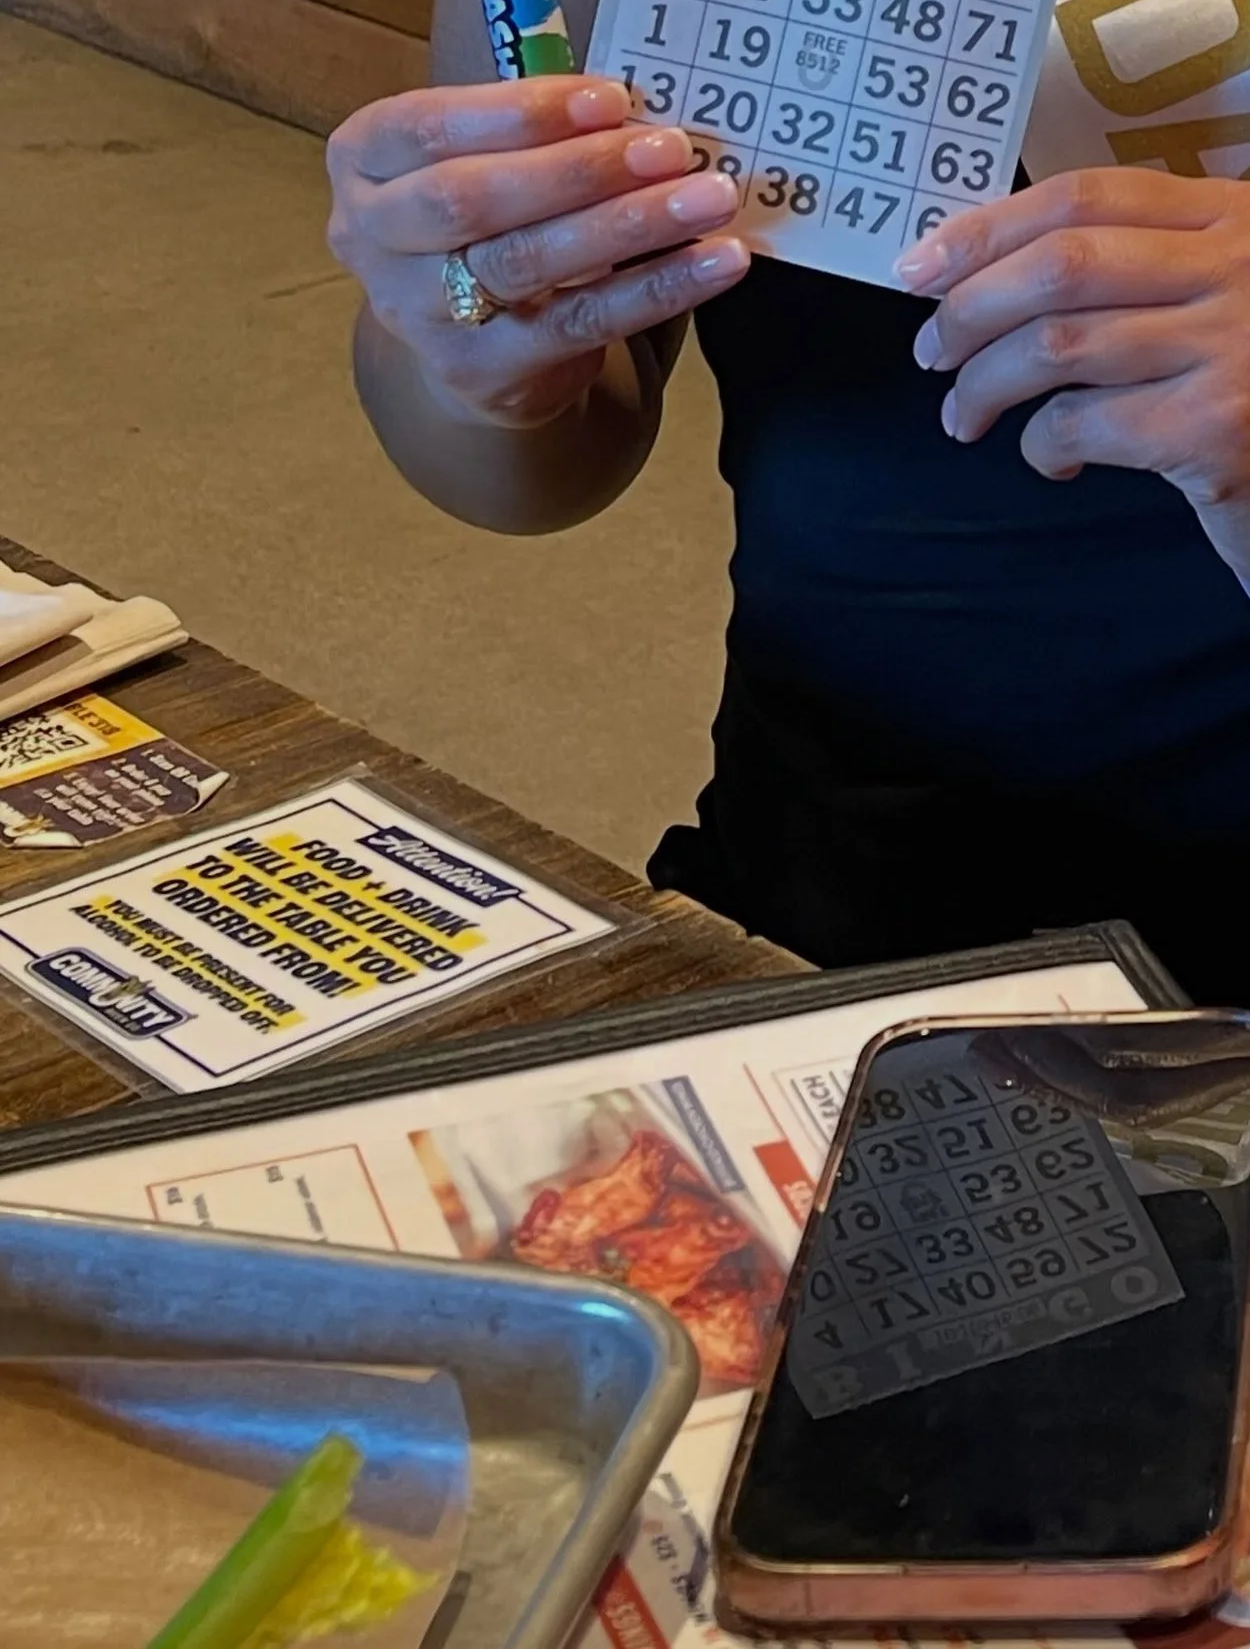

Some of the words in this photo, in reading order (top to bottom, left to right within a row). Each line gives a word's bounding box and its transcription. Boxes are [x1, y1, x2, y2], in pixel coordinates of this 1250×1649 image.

[643, 4, 667, 47] 1
[708, 19, 771, 68] 19
[803, 31, 847, 57] FREE
[863, 57, 930, 107] 53
[946, 76, 1011, 126] 62
[961, 10, 1019, 62] 71
[692, 82, 758, 132] 20
[772, 102, 835, 153] 32
[849, 121, 906, 173] 51
[930, 141, 994, 191] 63
[757, 165, 820, 216] 38
[835, 186, 900, 236] 47
[915, 206, 947, 243] 6
[186, 855, 235, 879] TO
[218, 874, 286, 909] THE
[266, 902, 360, 953] TABLE
[343, 945, 418, 985] YOU
[225, 837, 297, 877] WILL
[279, 871, 333, 896] BE
[312, 891, 464, 971] DELIVERED
[289, 840, 373, 880] FOOD
[375, 888, 480, 938] DRINK
[367, 834, 520, 899] Attention!
[50, 954, 175, 1027] COMMUNITY
[69, 905, 142, 947] ALCOHOL
[133, 943, 162, 958] TO
[152, 955, 182, 970] BE
[171, 967, 249, 1013] DROPPED
[104, 900, 140, 921] YOU
[137, 918, 185, 946] MUST
[175, 942, 204, 957] BE
[192, 952, 264, 995] PRESENT
[254, 993, 296, 1016] FOR
[152, 878, 277, 948] ORDERED
[259, 942, 363, 998] FROM!
